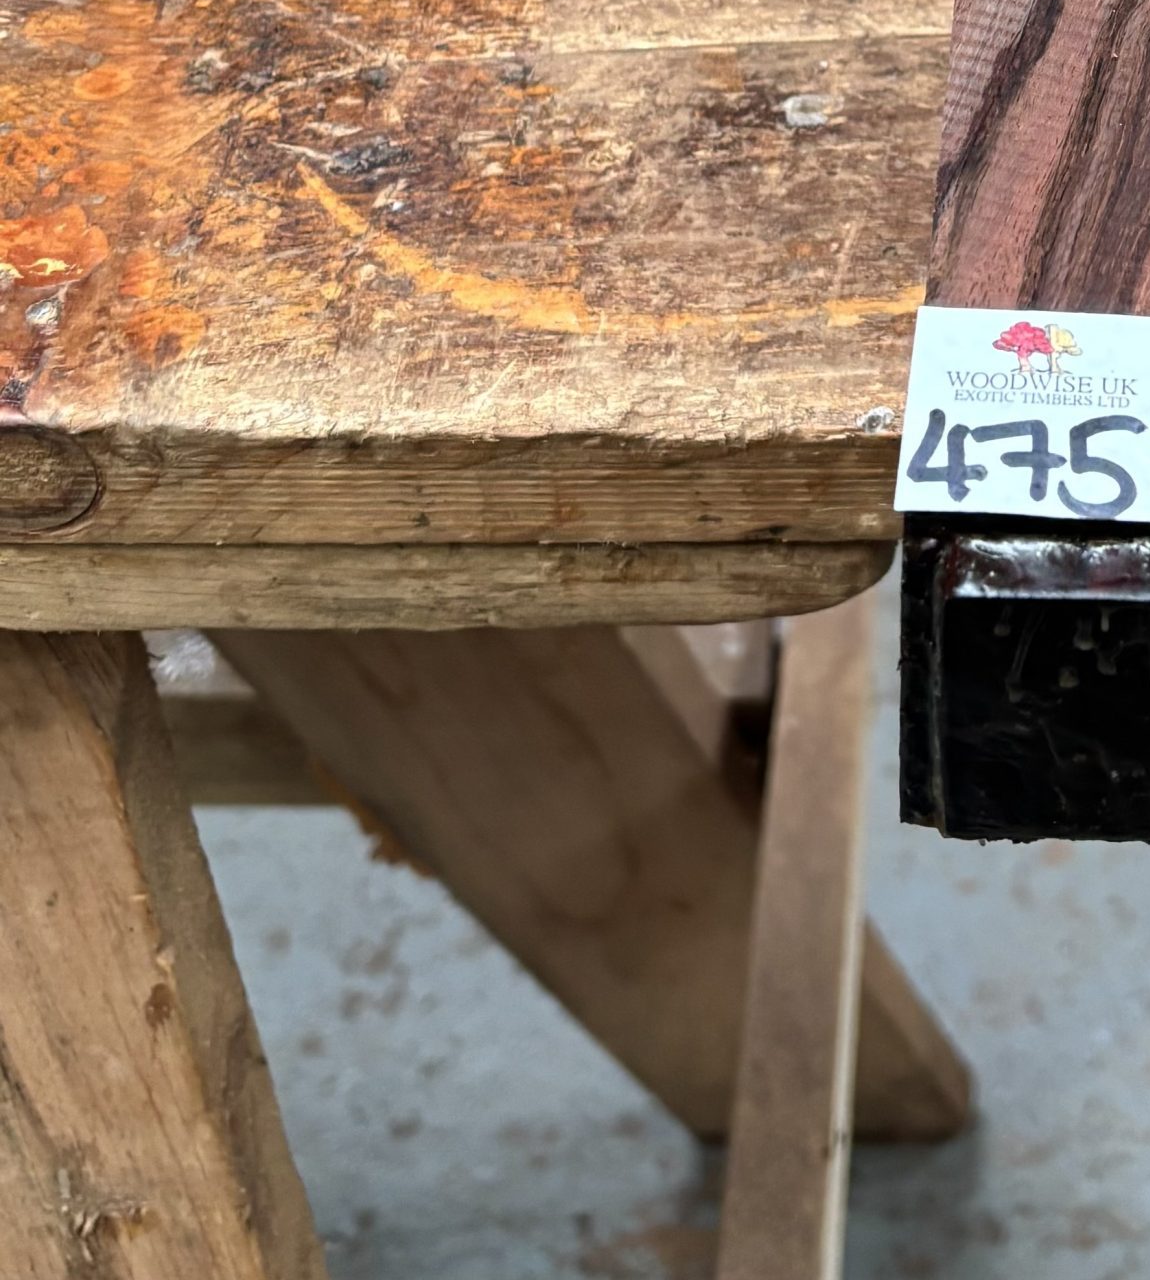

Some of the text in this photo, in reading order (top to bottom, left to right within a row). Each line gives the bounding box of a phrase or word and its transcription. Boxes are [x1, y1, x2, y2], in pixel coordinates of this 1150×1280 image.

[946, 371, 1139, 396] WOODWISE UK
[954, 389, 1131, 408] EXOTIC TIMBERS LTD
[906, 408, 1148, 519] 475
